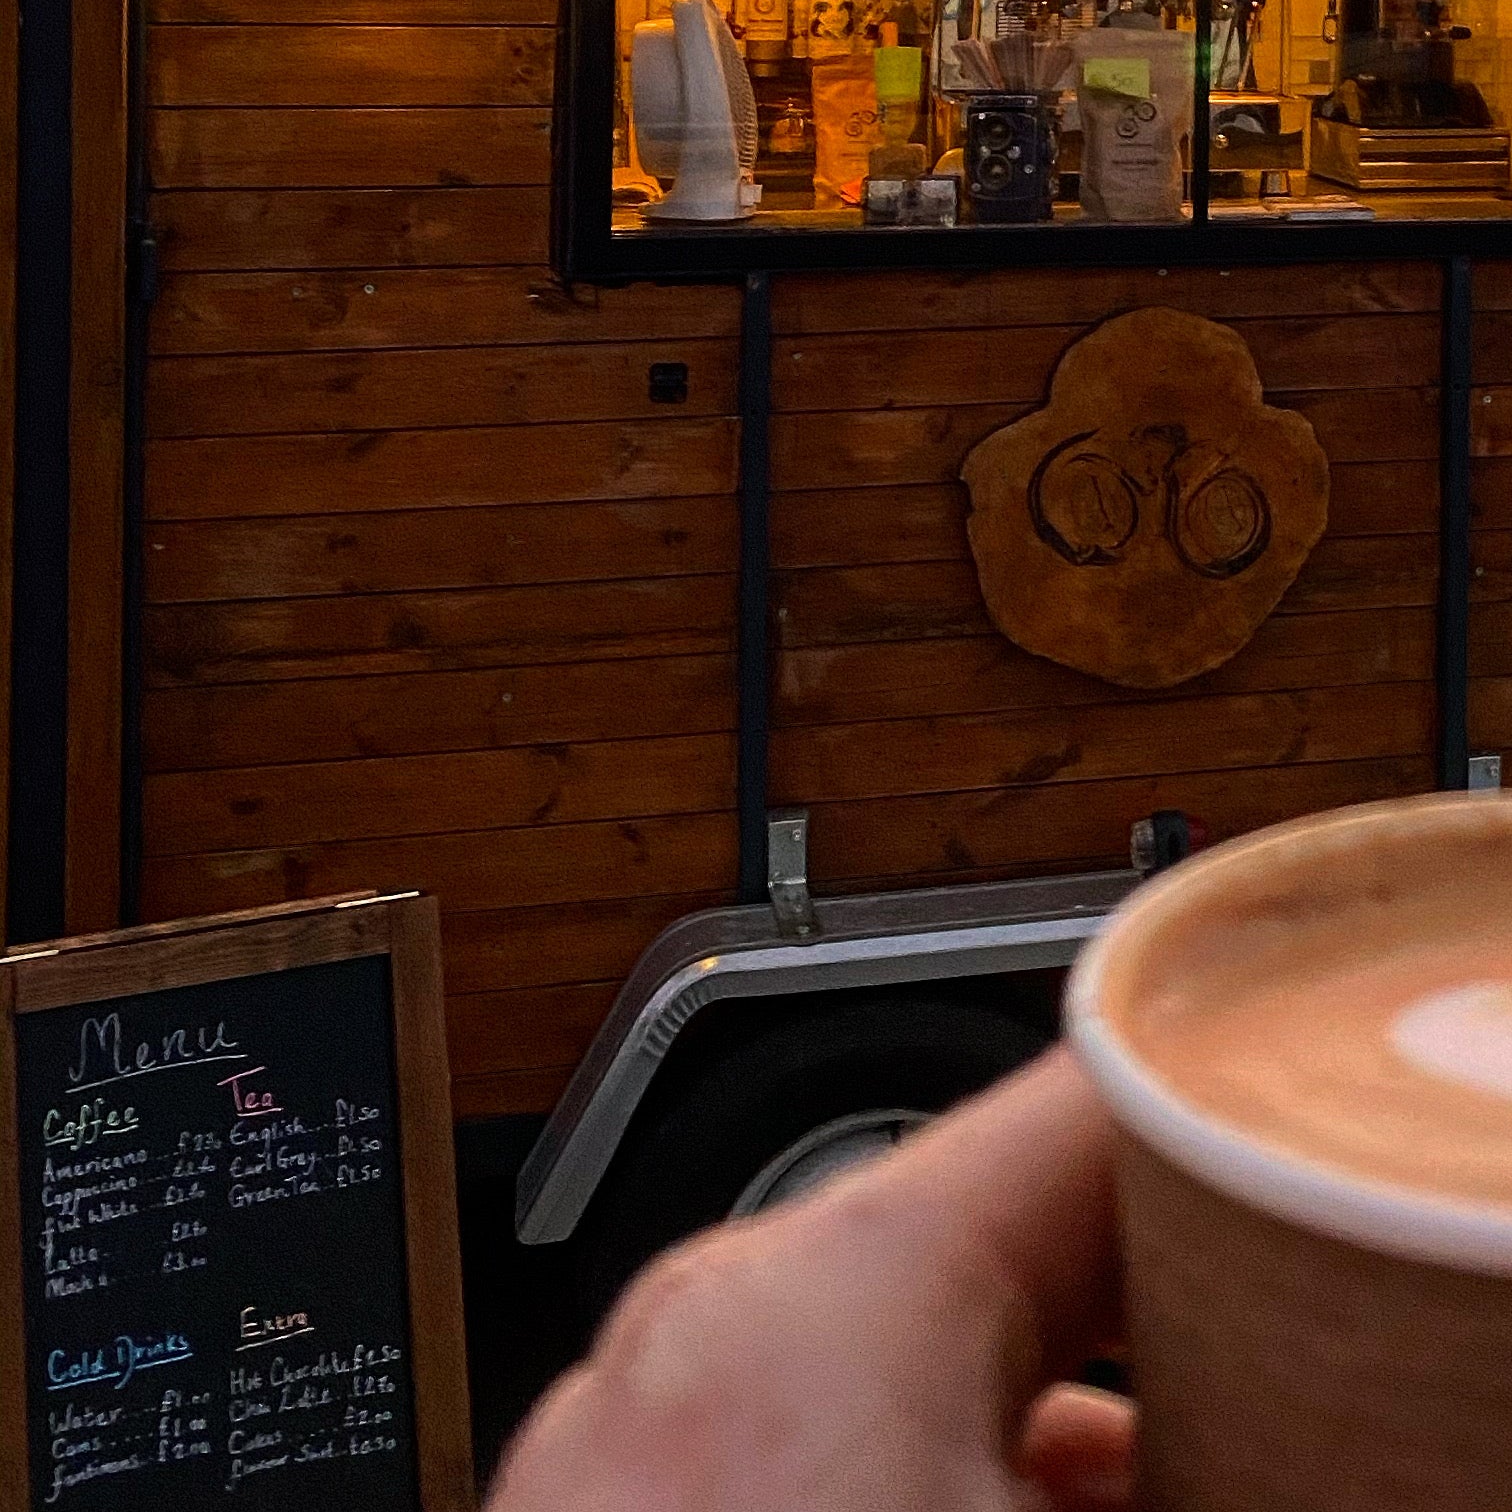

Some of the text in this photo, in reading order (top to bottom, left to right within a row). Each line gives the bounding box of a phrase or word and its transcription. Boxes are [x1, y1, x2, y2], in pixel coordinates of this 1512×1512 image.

[68, 1012, 240, 1082] Menu
[216, 1065, 273, 1112] Tea
[43, 1097, 140, 1151] Coffee
[229, 1116, 307, 1158] English
[43, 1148, 148, 1184] Americano
[48, 1335, 191, 1389] Cold Drinks
[48, 1402, 123, 1435] Water
